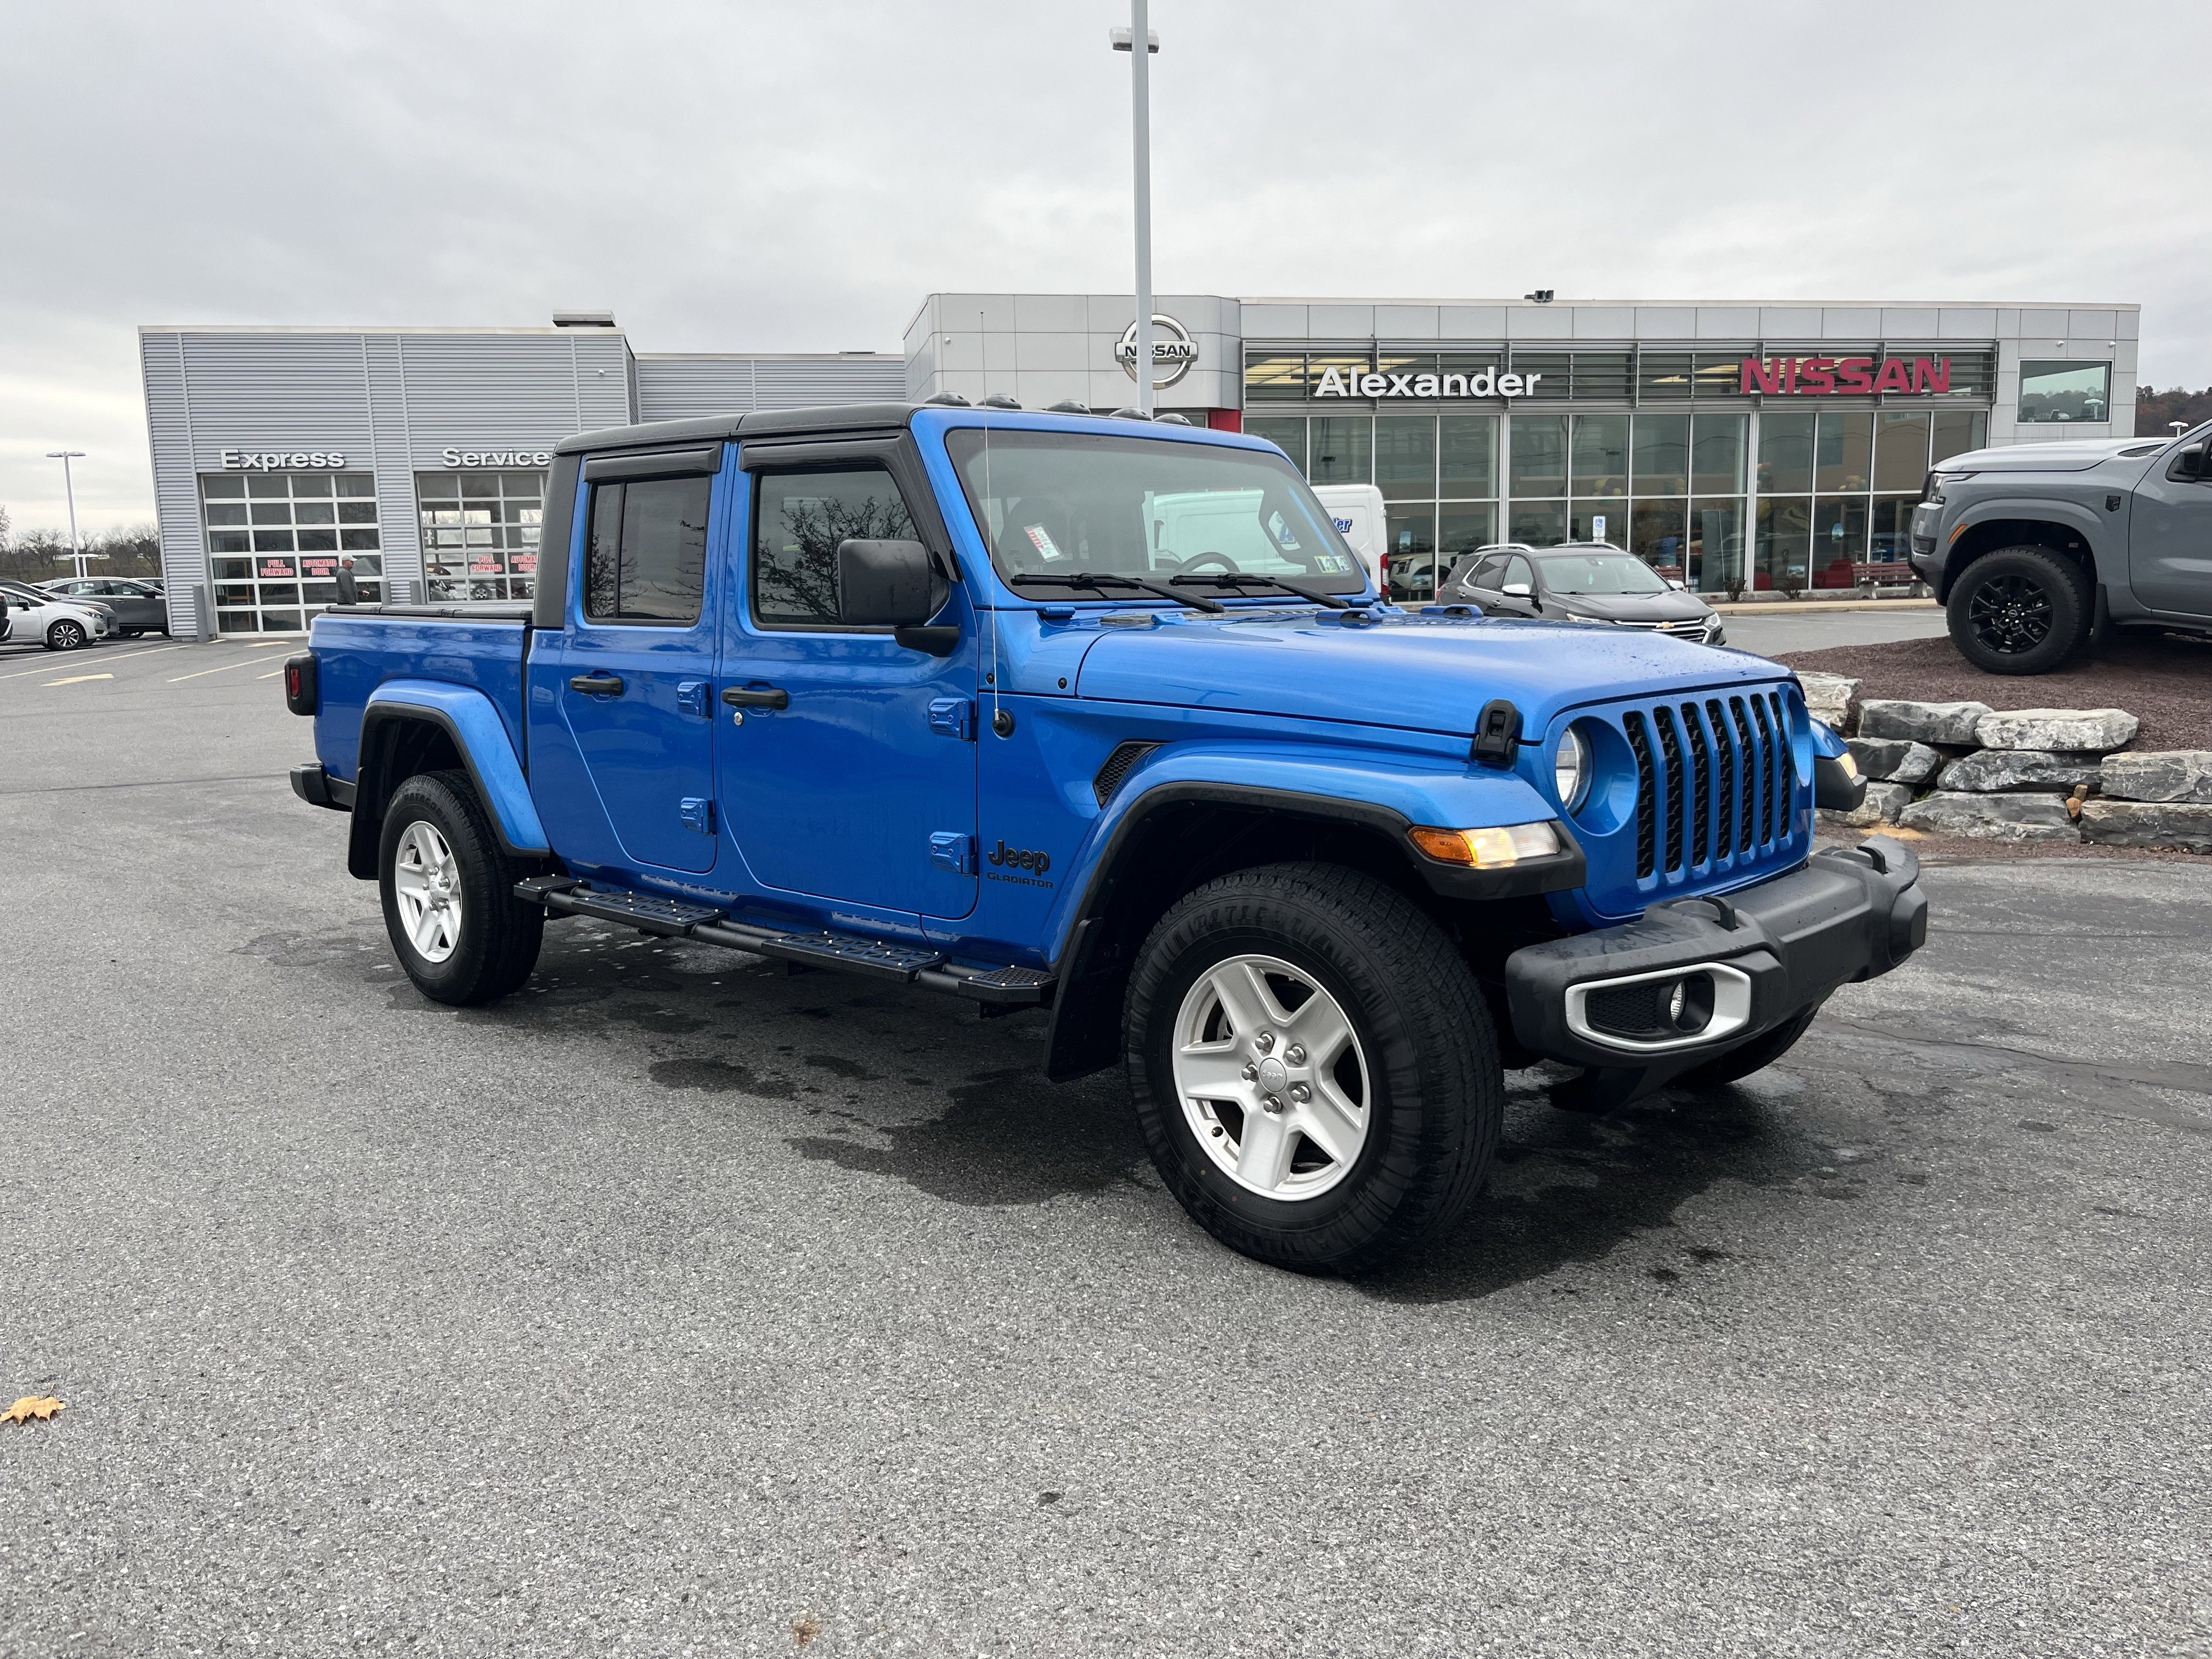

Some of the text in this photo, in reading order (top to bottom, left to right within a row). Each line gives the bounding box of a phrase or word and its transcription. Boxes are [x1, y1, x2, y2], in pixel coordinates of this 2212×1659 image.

[1125, 345, 1191, 358] NSAN
[1314, 366, 1541, 397] Alexander
[1741, 358, 1951, 394] NISSAN
[220, 449, 346, 472] Express
[442, 448, 550, 466] Service
[267, 560, 286, 568] PULL
[303, 559, 337, 567] AUTOMATIC
[478, 556, 495, 564] PULL
[989, 839, 1051, 876] Jeep
[987, 872, 1054, 889] GLADIATOR
[1262, 1069, 1283, 1081] Jeep
